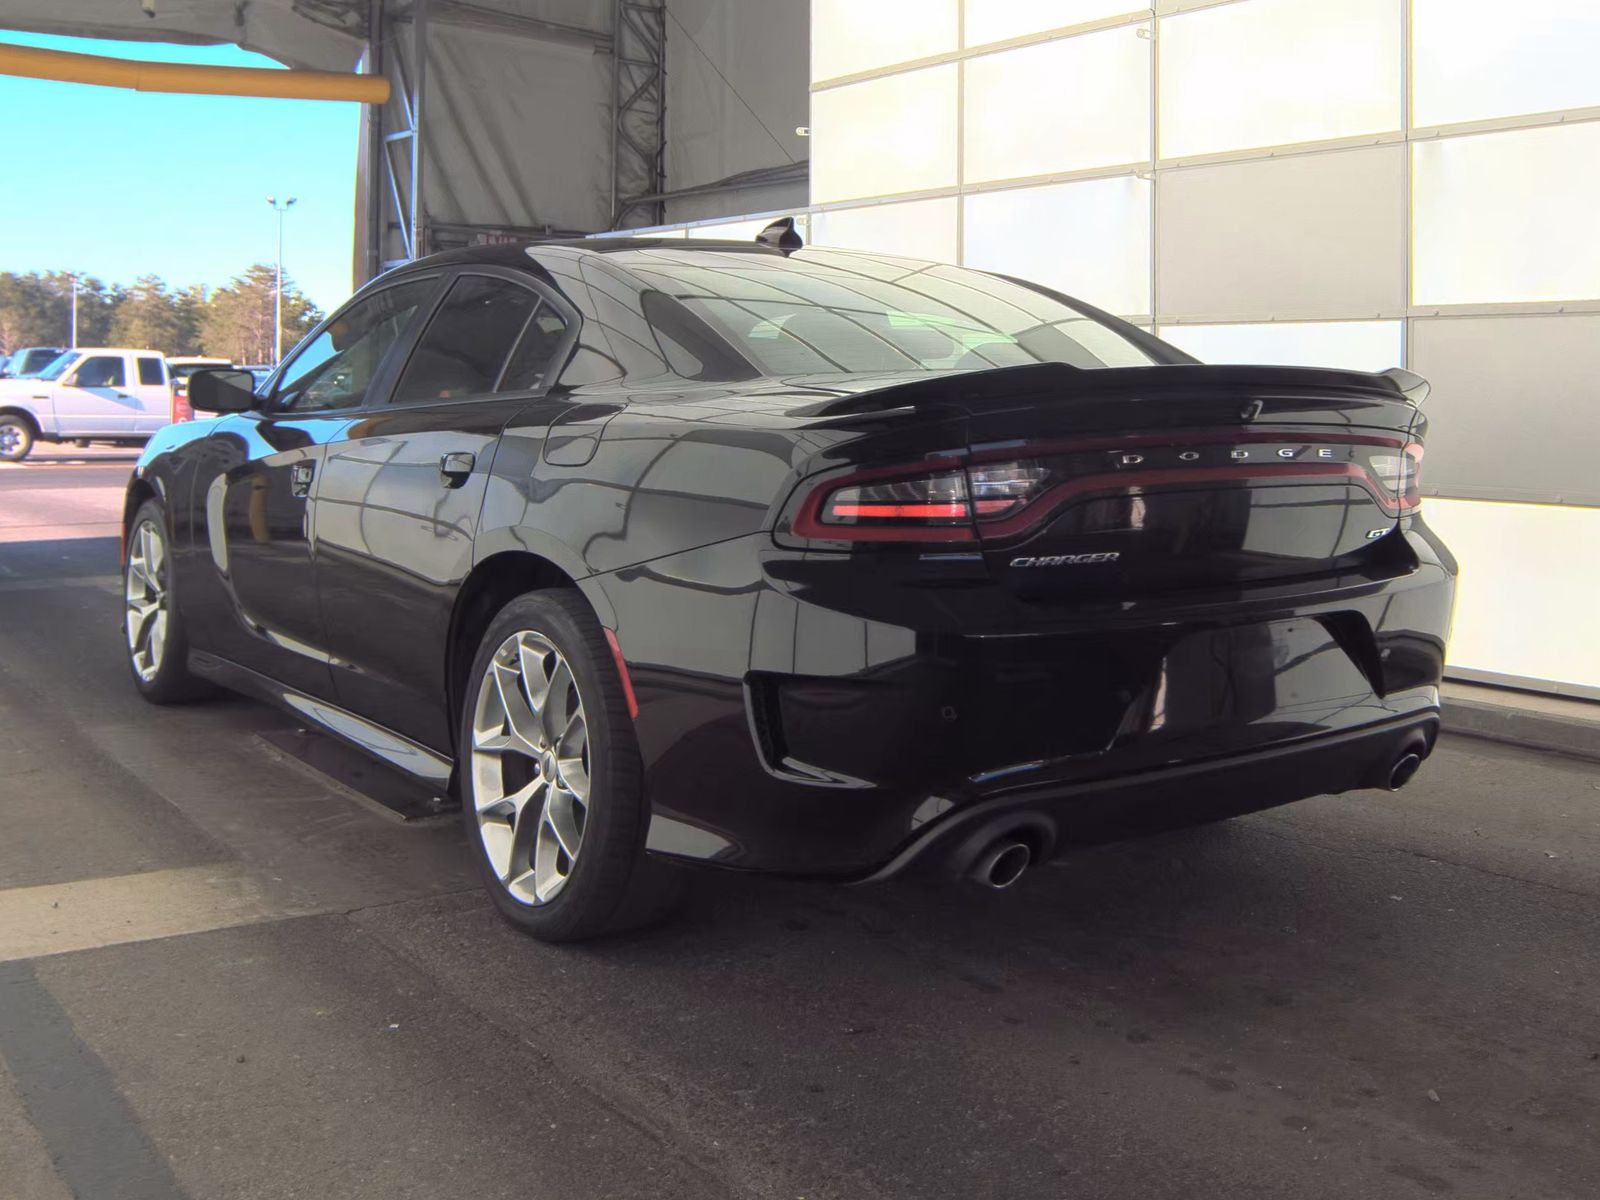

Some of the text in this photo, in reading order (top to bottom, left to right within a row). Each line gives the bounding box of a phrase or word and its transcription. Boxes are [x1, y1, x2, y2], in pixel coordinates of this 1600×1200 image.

[1122, 448, 1332, 464] DODGE
[1366, 527, 1391, 539] GT
[1009, 552, 1120, 567] CHARGER
